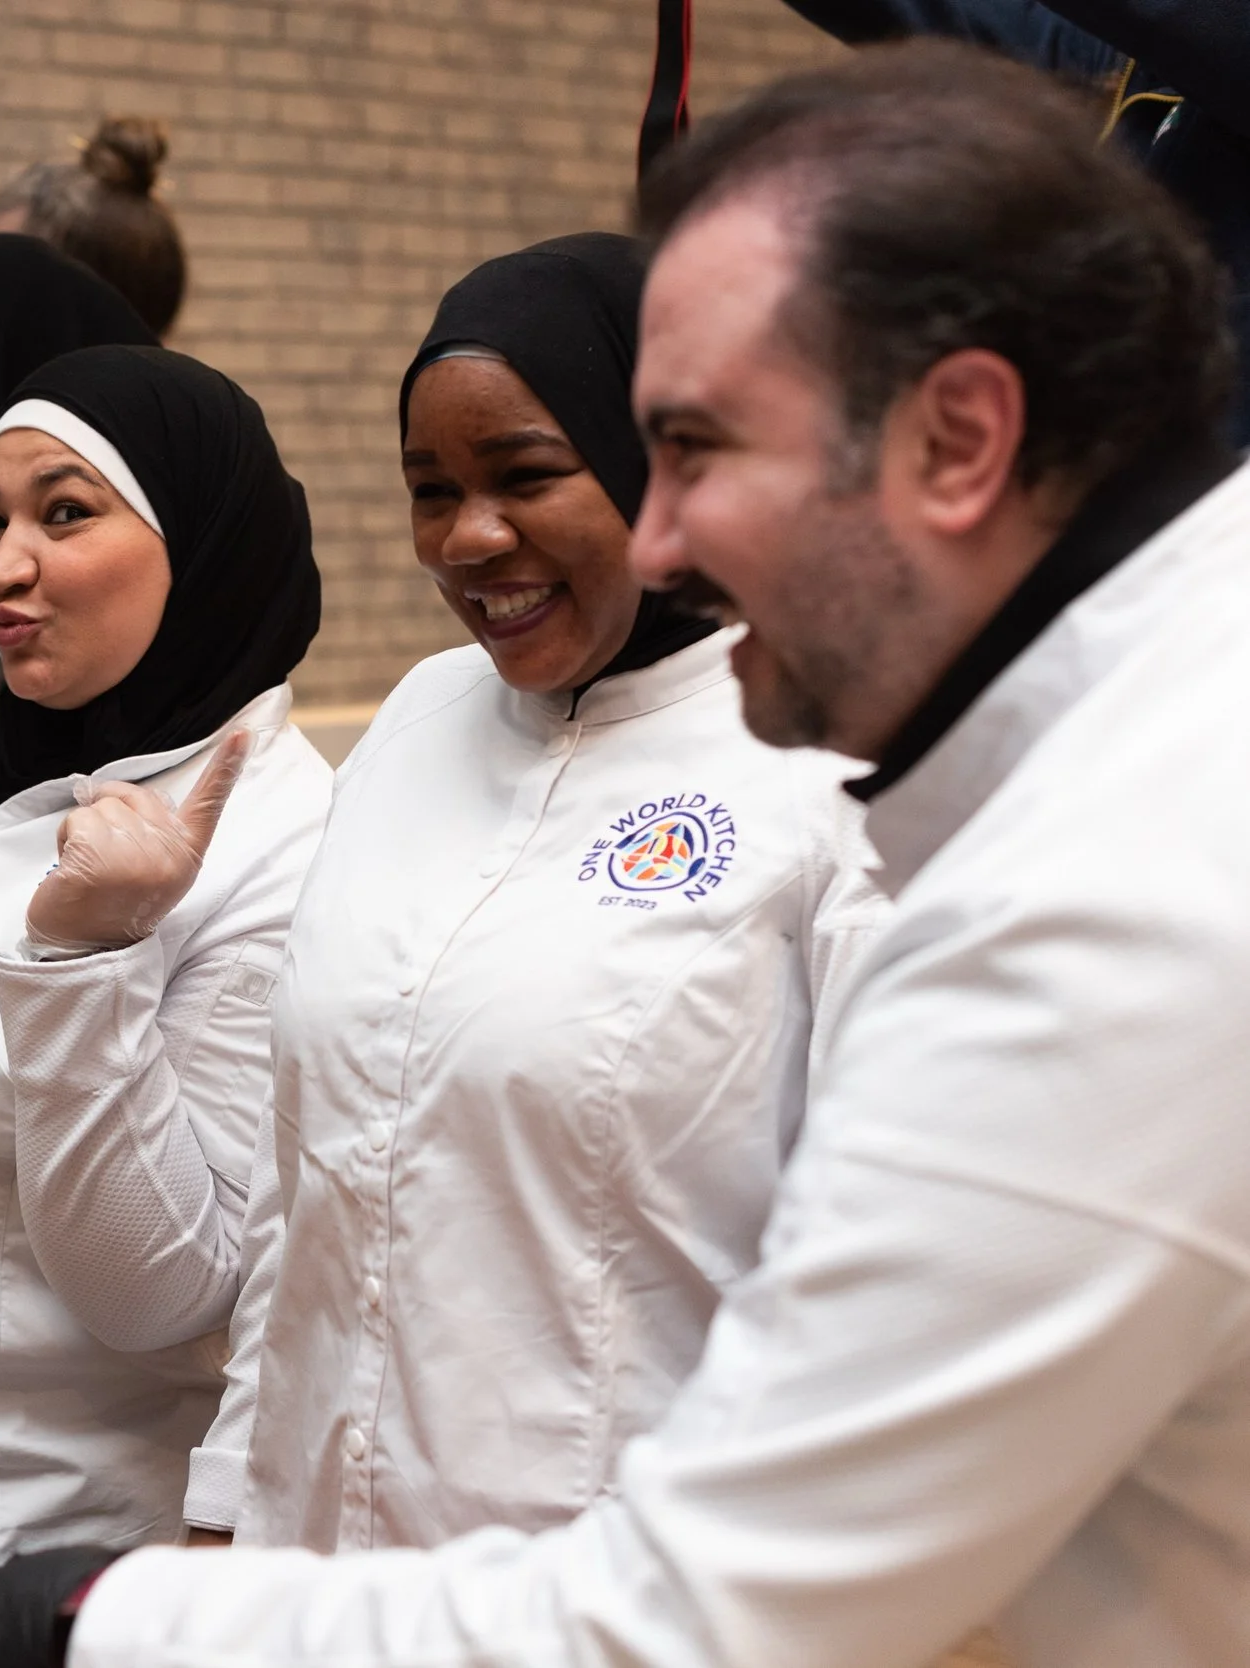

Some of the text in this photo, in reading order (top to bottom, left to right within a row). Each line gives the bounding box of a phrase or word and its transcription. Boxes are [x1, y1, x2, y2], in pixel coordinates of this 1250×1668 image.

[578, 793, 736, 903] ONE WORLD KITCHEN
[598, 896, 658, 911] EST 2023
